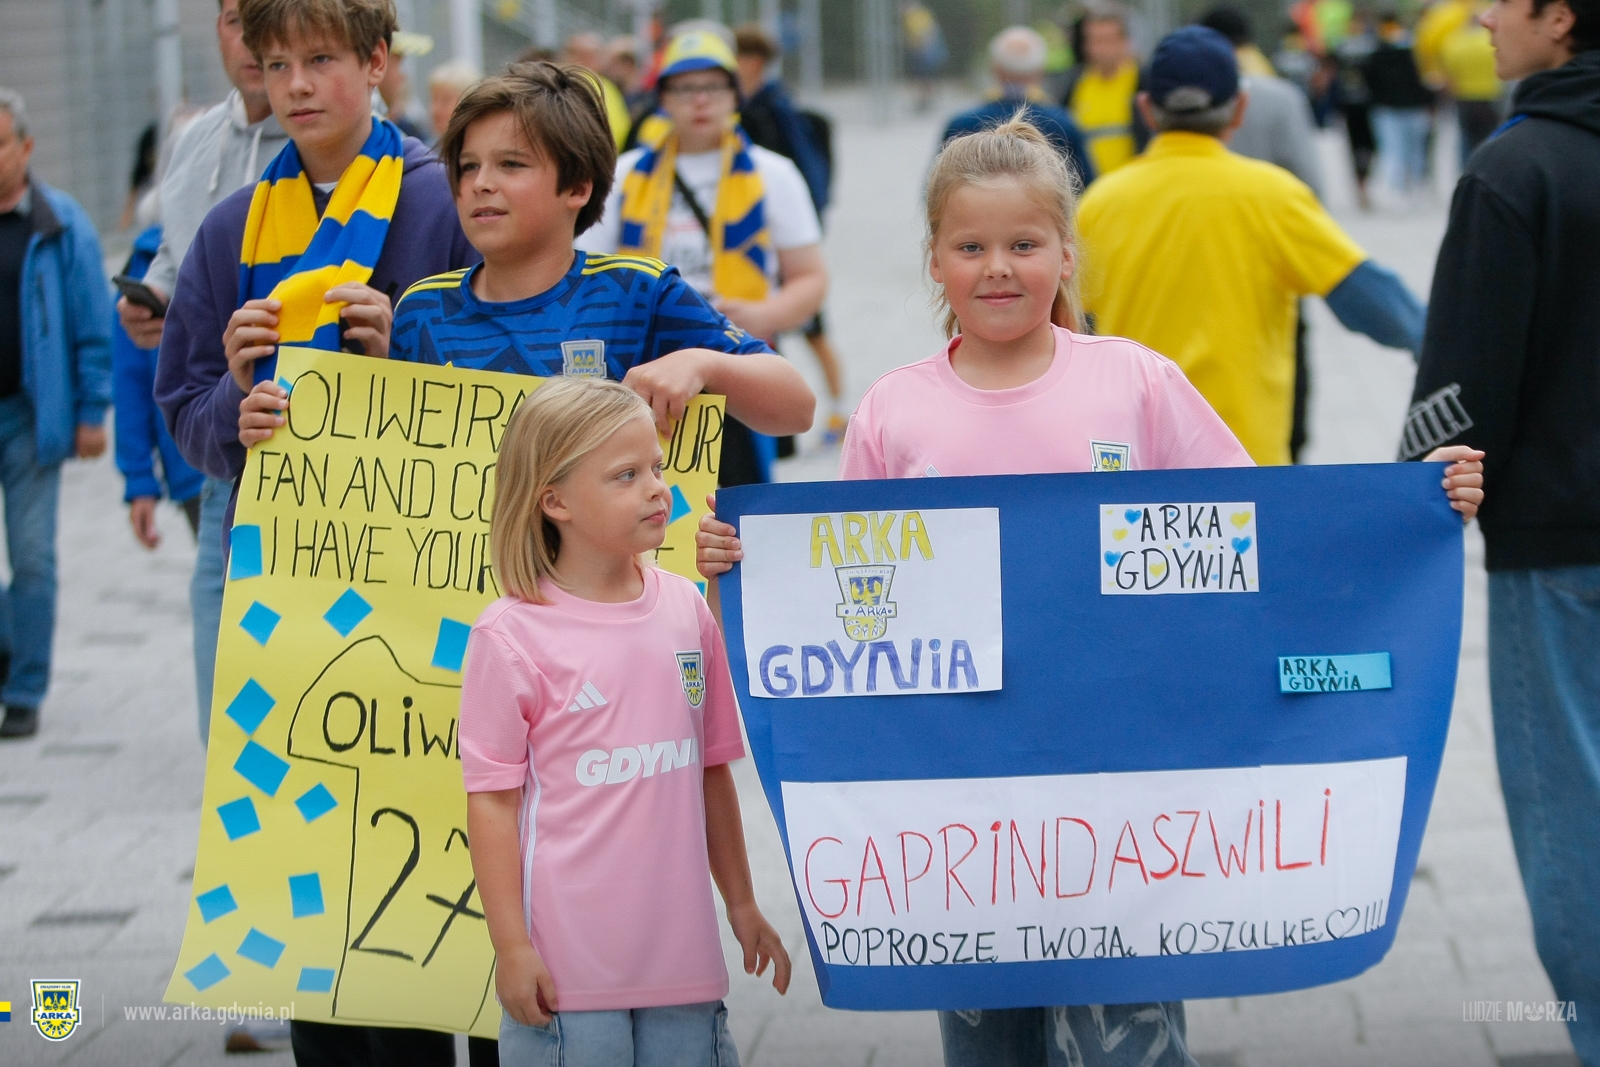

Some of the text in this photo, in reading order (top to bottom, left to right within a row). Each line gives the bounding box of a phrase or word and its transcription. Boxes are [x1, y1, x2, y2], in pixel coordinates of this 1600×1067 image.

[256, 451, 497, 523] FAN AND CO
[270, 516, 279, 576] I
[292, 521, 392, 583] HAVE
[809, 511, 935, 568] ARKA
[1140, 504, 1223, 542] ARKA
[855, 606, 888, 617] ARKA
[1283, 658, 1339, 677] ARKA
[322, 691, 461, 760] OLiW
[575, 738, 699, 787] GDYNI
